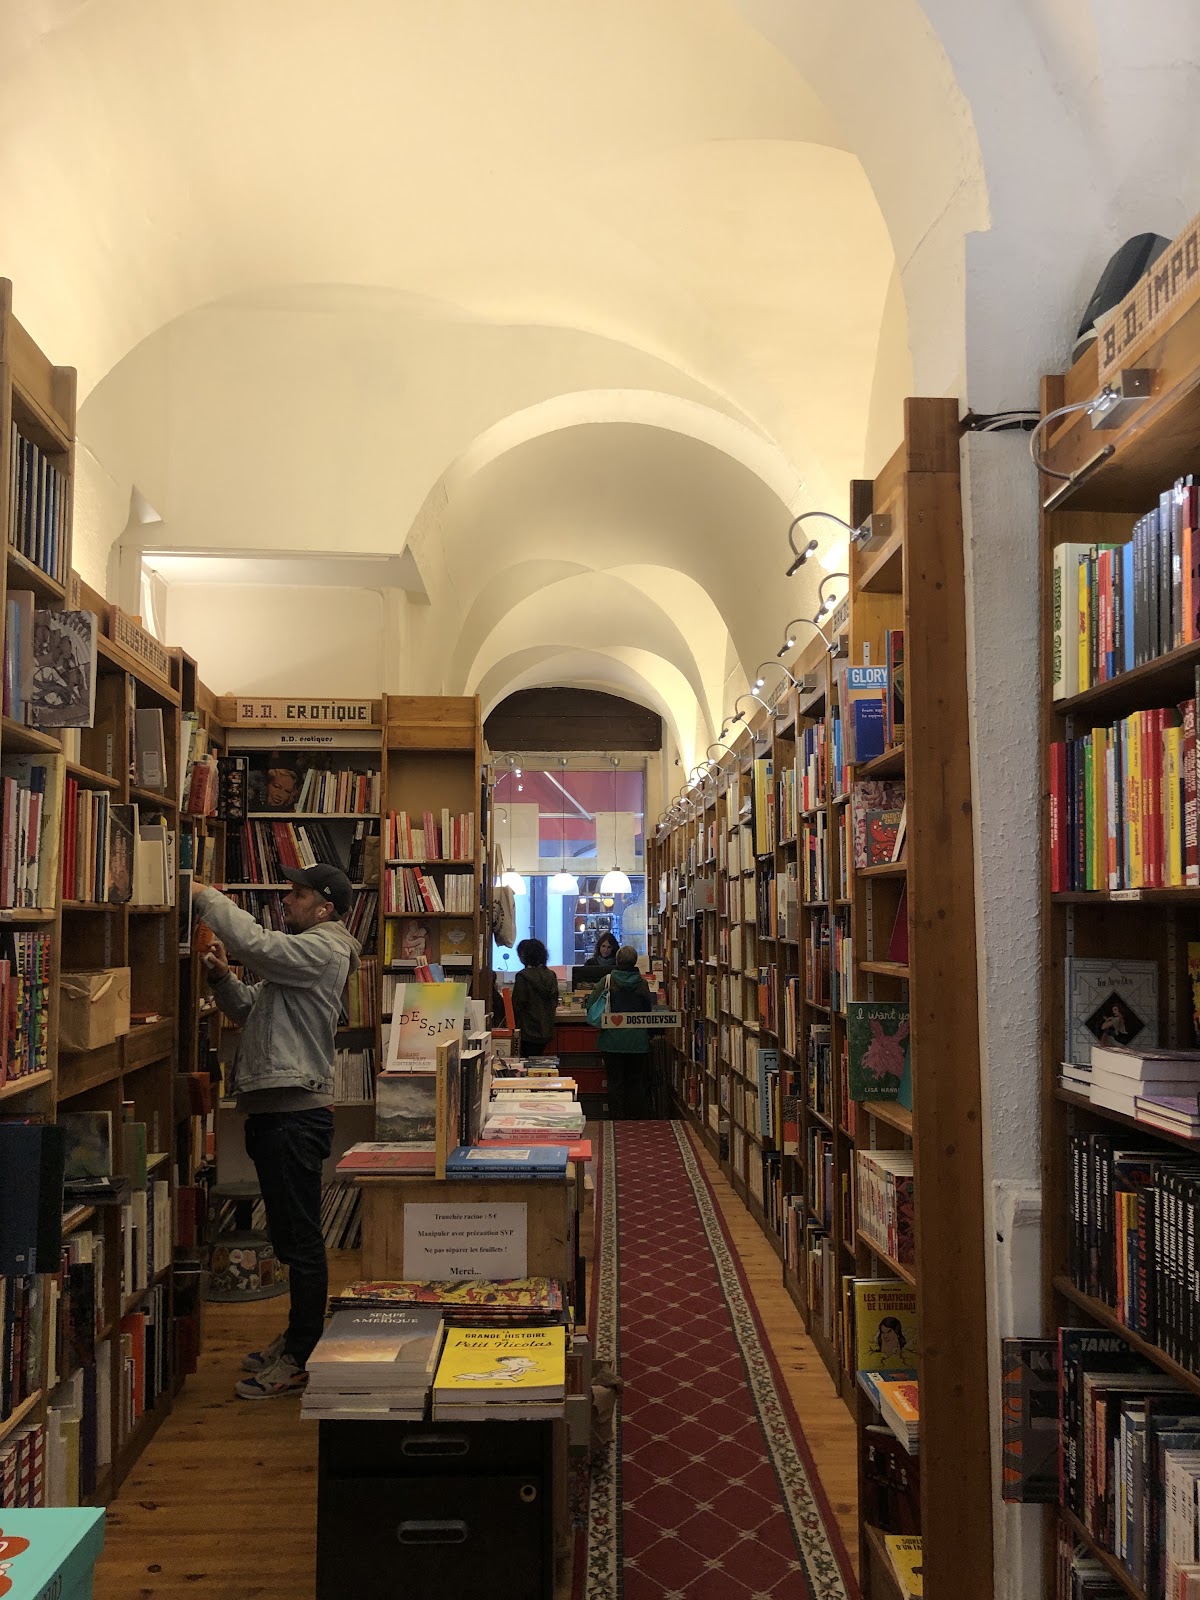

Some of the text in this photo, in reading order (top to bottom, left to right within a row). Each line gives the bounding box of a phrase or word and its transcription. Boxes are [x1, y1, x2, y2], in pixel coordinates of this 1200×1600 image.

[852, 668, 888, 683] GLORY
[242, 704, 277, 719] B.D.
[604, 1015, 677, 1025] I DOSTOIEVSKI
[868, 1008, 896, 1020] want
[399, 1011, 456, 1037] DESSIN
[418, 1230, 450, 1238] Manipuler
[864, 1293, 916, 1302] LES PRATICIEN
[494, 1340, 553, 1348] Nicolas
[1079, 1337, 1122, 1353] TANK
